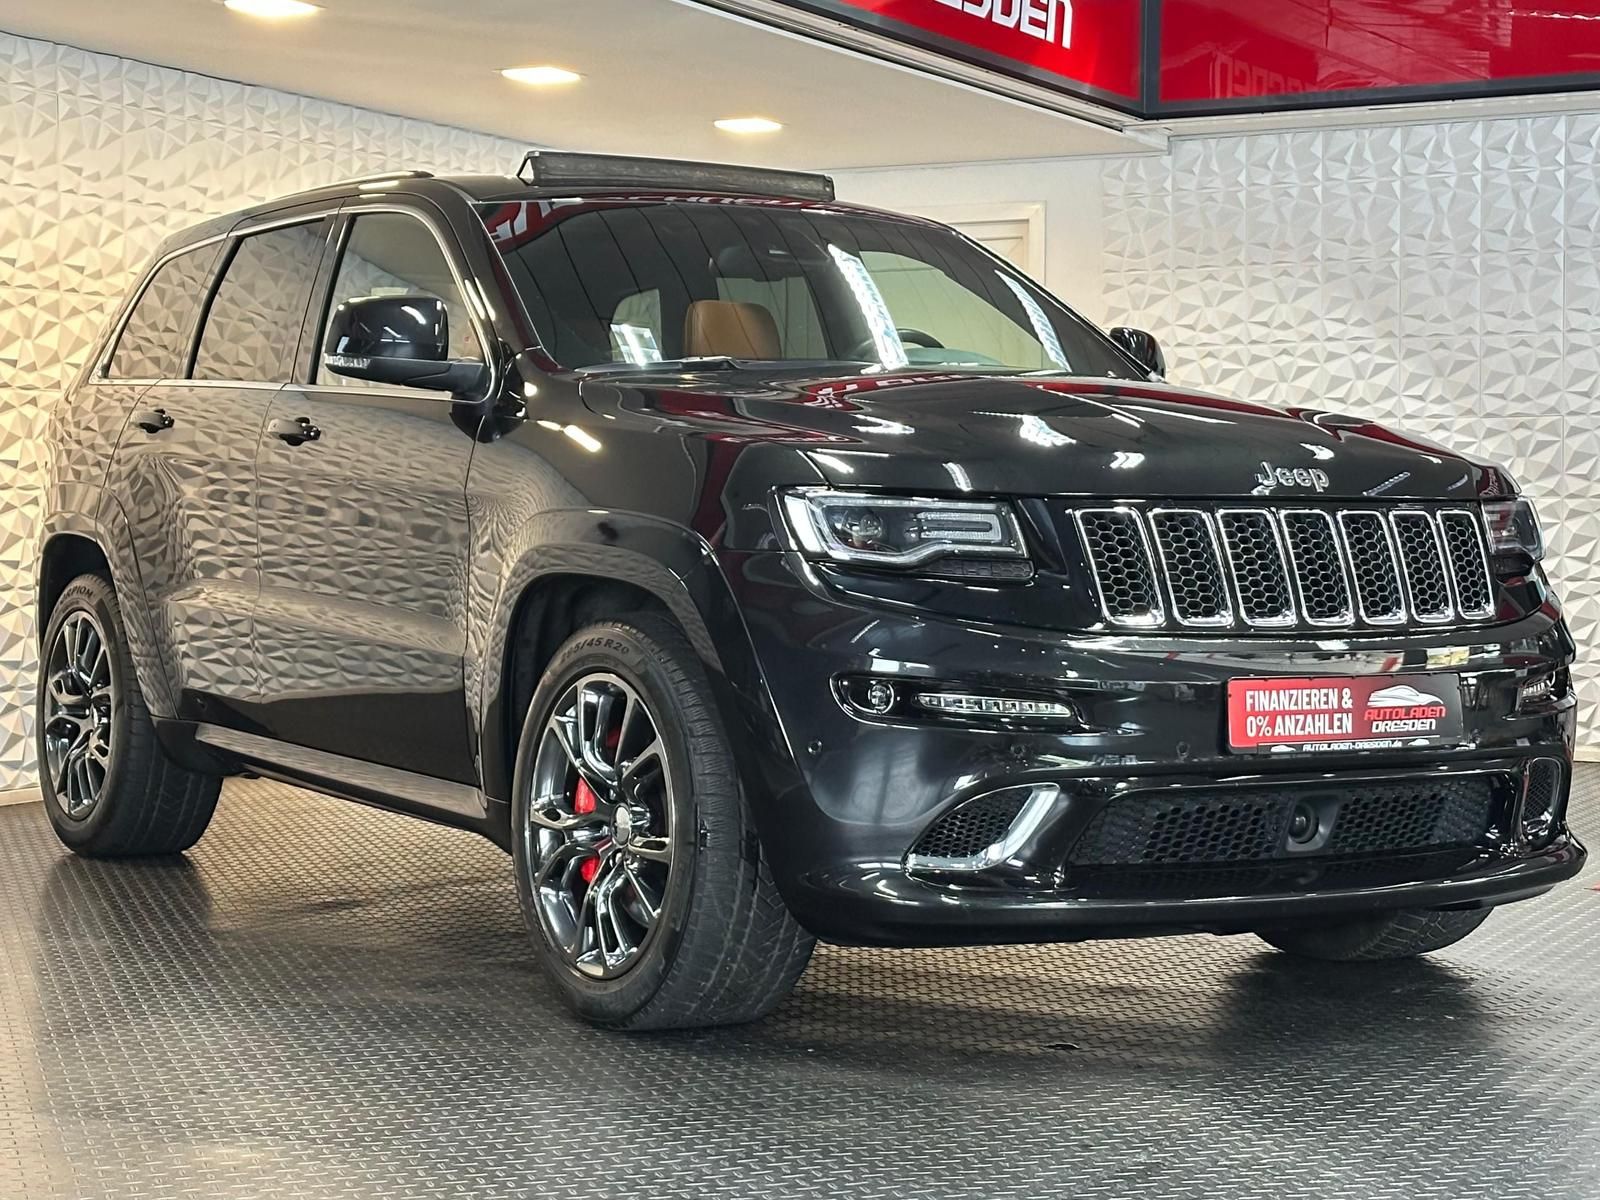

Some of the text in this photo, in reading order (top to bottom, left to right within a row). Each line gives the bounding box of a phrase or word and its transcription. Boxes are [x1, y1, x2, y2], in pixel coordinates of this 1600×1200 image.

[1255, 461, 1329, 492] Jeep
[1245, 688, 1353, 712] FINANZIEREN &
[1246, 713, 1353, 737] 0% ANZAHLEN
[1364, 706, 1446, 720] AUTOLADEN
[1371, 718, 1437, 733] DRESDEN
